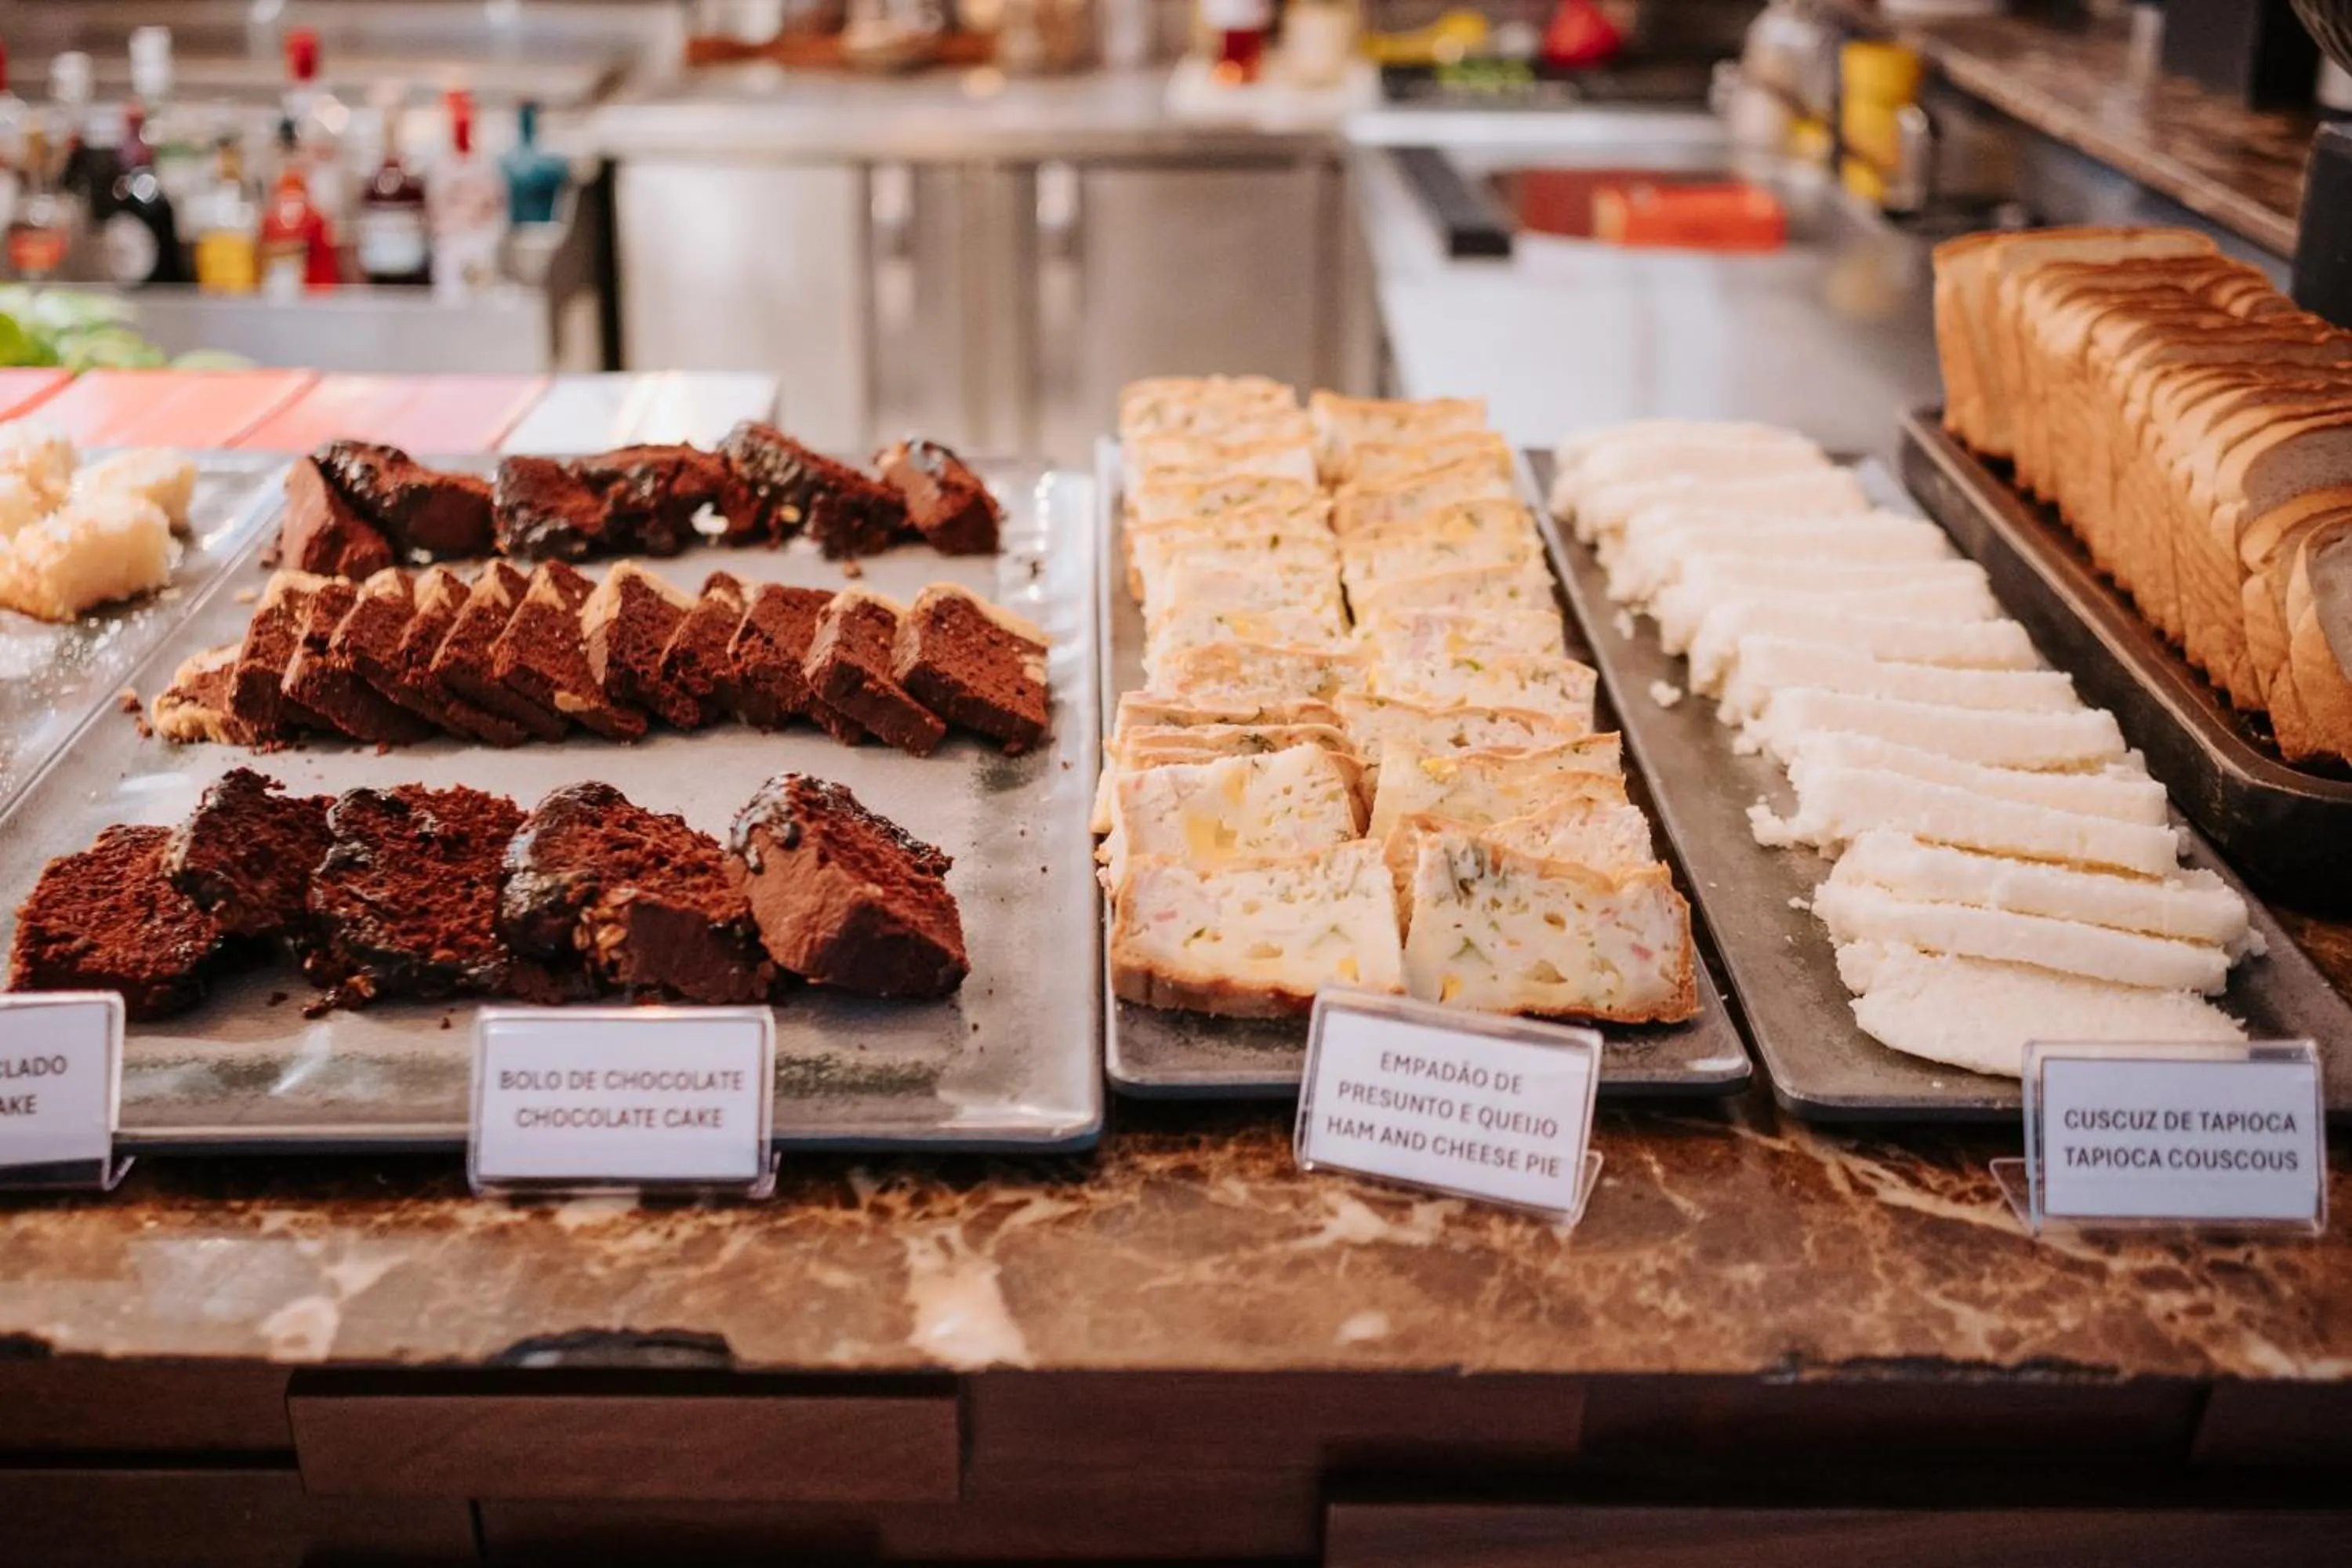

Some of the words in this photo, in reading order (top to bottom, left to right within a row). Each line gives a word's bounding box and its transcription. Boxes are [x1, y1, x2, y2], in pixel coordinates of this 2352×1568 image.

[0, 1055, 67, 1078] LADO
[1380, 1052, 1489, 1088] EMPADÃO
[1494, 1071, 1523, 1094] DE
[499, 1070, 561, 1091] BOLO
[568, 1070, 596, 1091] DE
[603, 1070, 744, 1091] CHOCOLATE
[515, 1109, 656, 1128] CHOCOLATE
[663, 1109, 723, 1128] CAKE
[1338, 1080, 1454, 1118] PRESUNTO
[1460, 1103, 1472, 1123] E
[1478, 1105, 1558, 1138] QUEIJO
[2064, 1109, 2158, 1131] CUSCUZ
[2164, 1111, 2192, 1131] DE
[2198, 1111, 2297, 1133] TAPIOCA
[1327, 1116, 1374, 1141] HAM
[1379, 1127, 1427, 1152] AND
[1432, 1136, 1519, 1169] CHEESE
[1526, 1152, 1559, 1178] PIE
[2065, 1147, 2161, 1168] TAPIOCA
[2168, 1148, 2299, 1171] COUSCOUS
